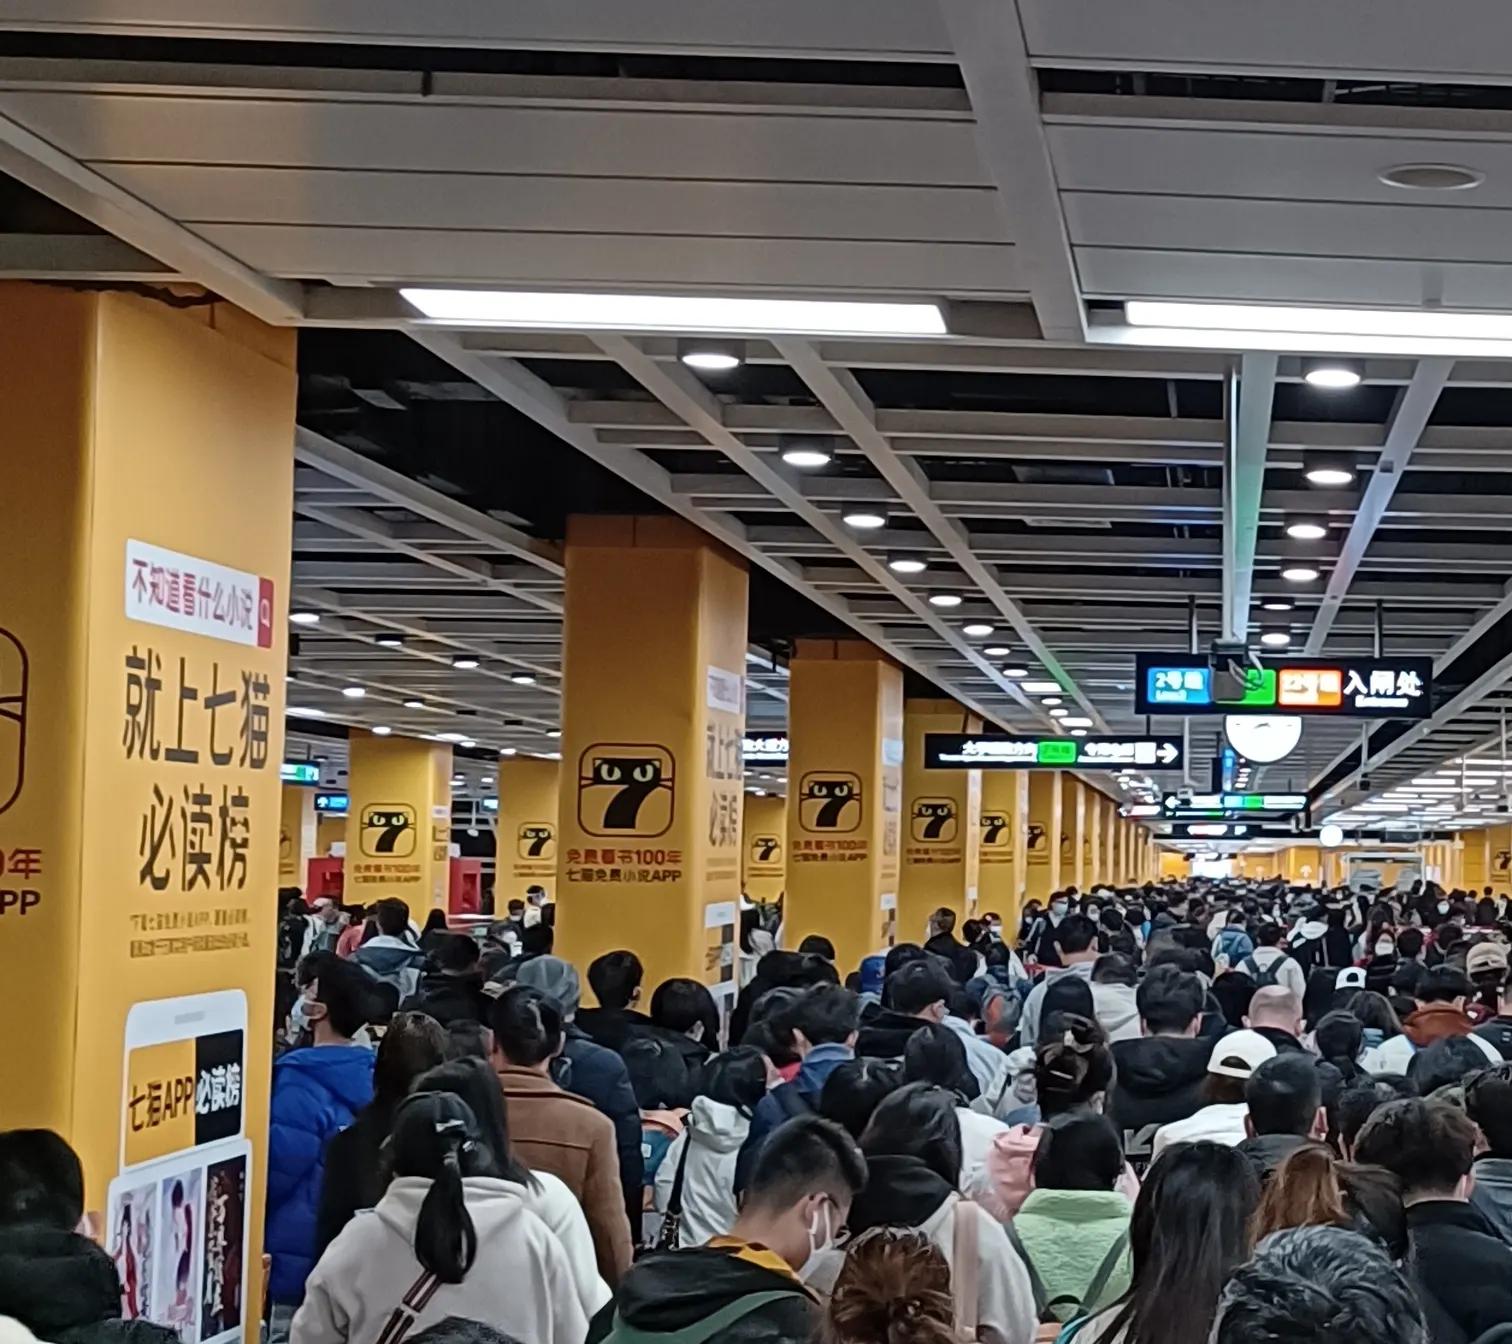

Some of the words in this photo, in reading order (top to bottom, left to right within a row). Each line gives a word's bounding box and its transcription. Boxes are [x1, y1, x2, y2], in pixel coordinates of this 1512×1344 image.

[131, 558, 254, 631] 不知道看什么小说
[122, 644, 271, 770] 就上七猫
[0, 848, 43, 881] 年
[139, 782, 250, 892] 必读榜
